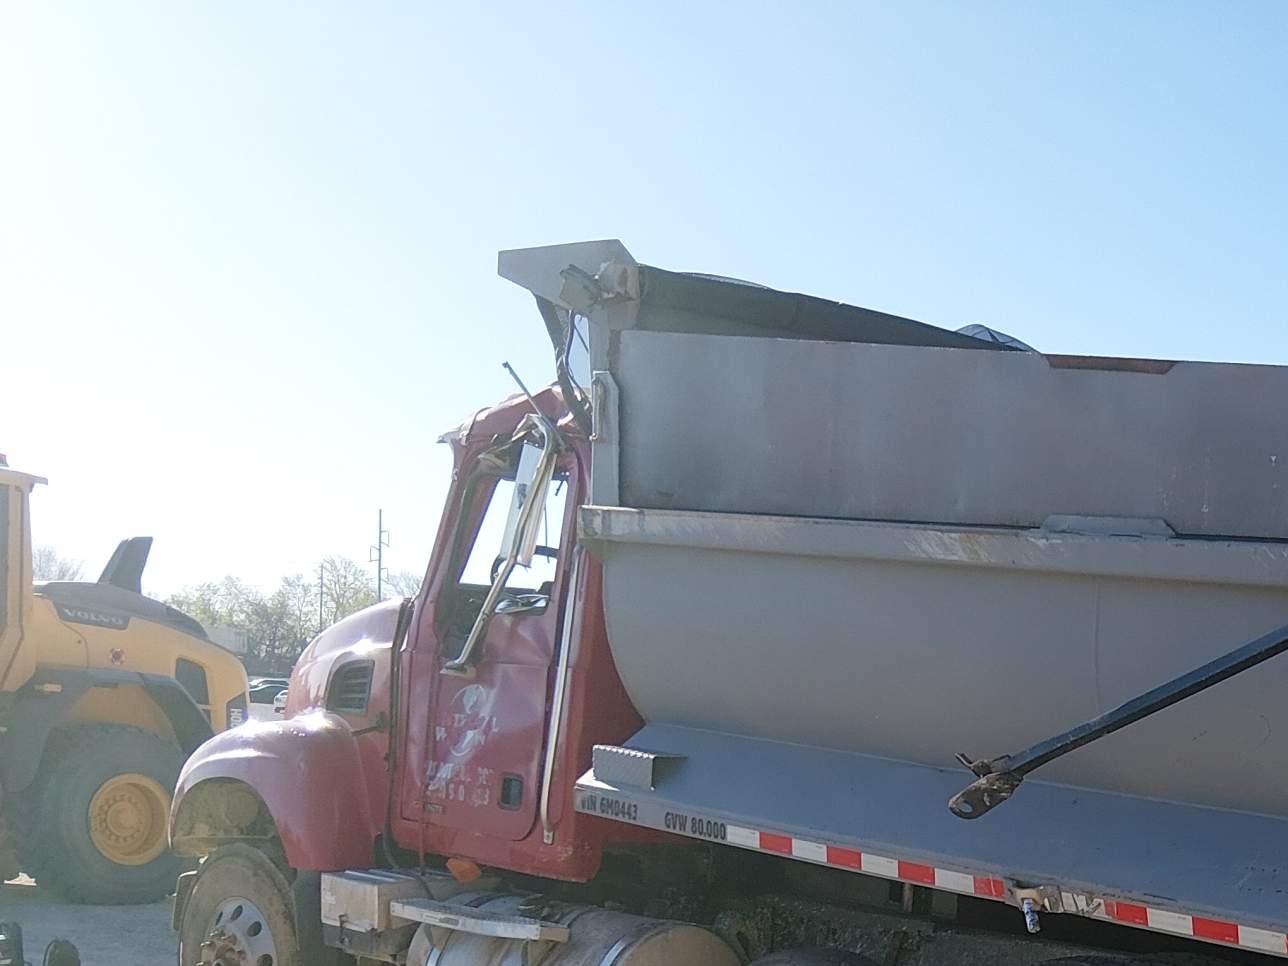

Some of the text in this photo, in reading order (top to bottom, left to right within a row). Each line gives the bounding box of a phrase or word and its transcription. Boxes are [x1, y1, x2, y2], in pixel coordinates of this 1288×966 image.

[63, 607, 124, 625] VOLVO
[581, 794, 597, 812] VIN
[664, 811, 688, 832] GVW
